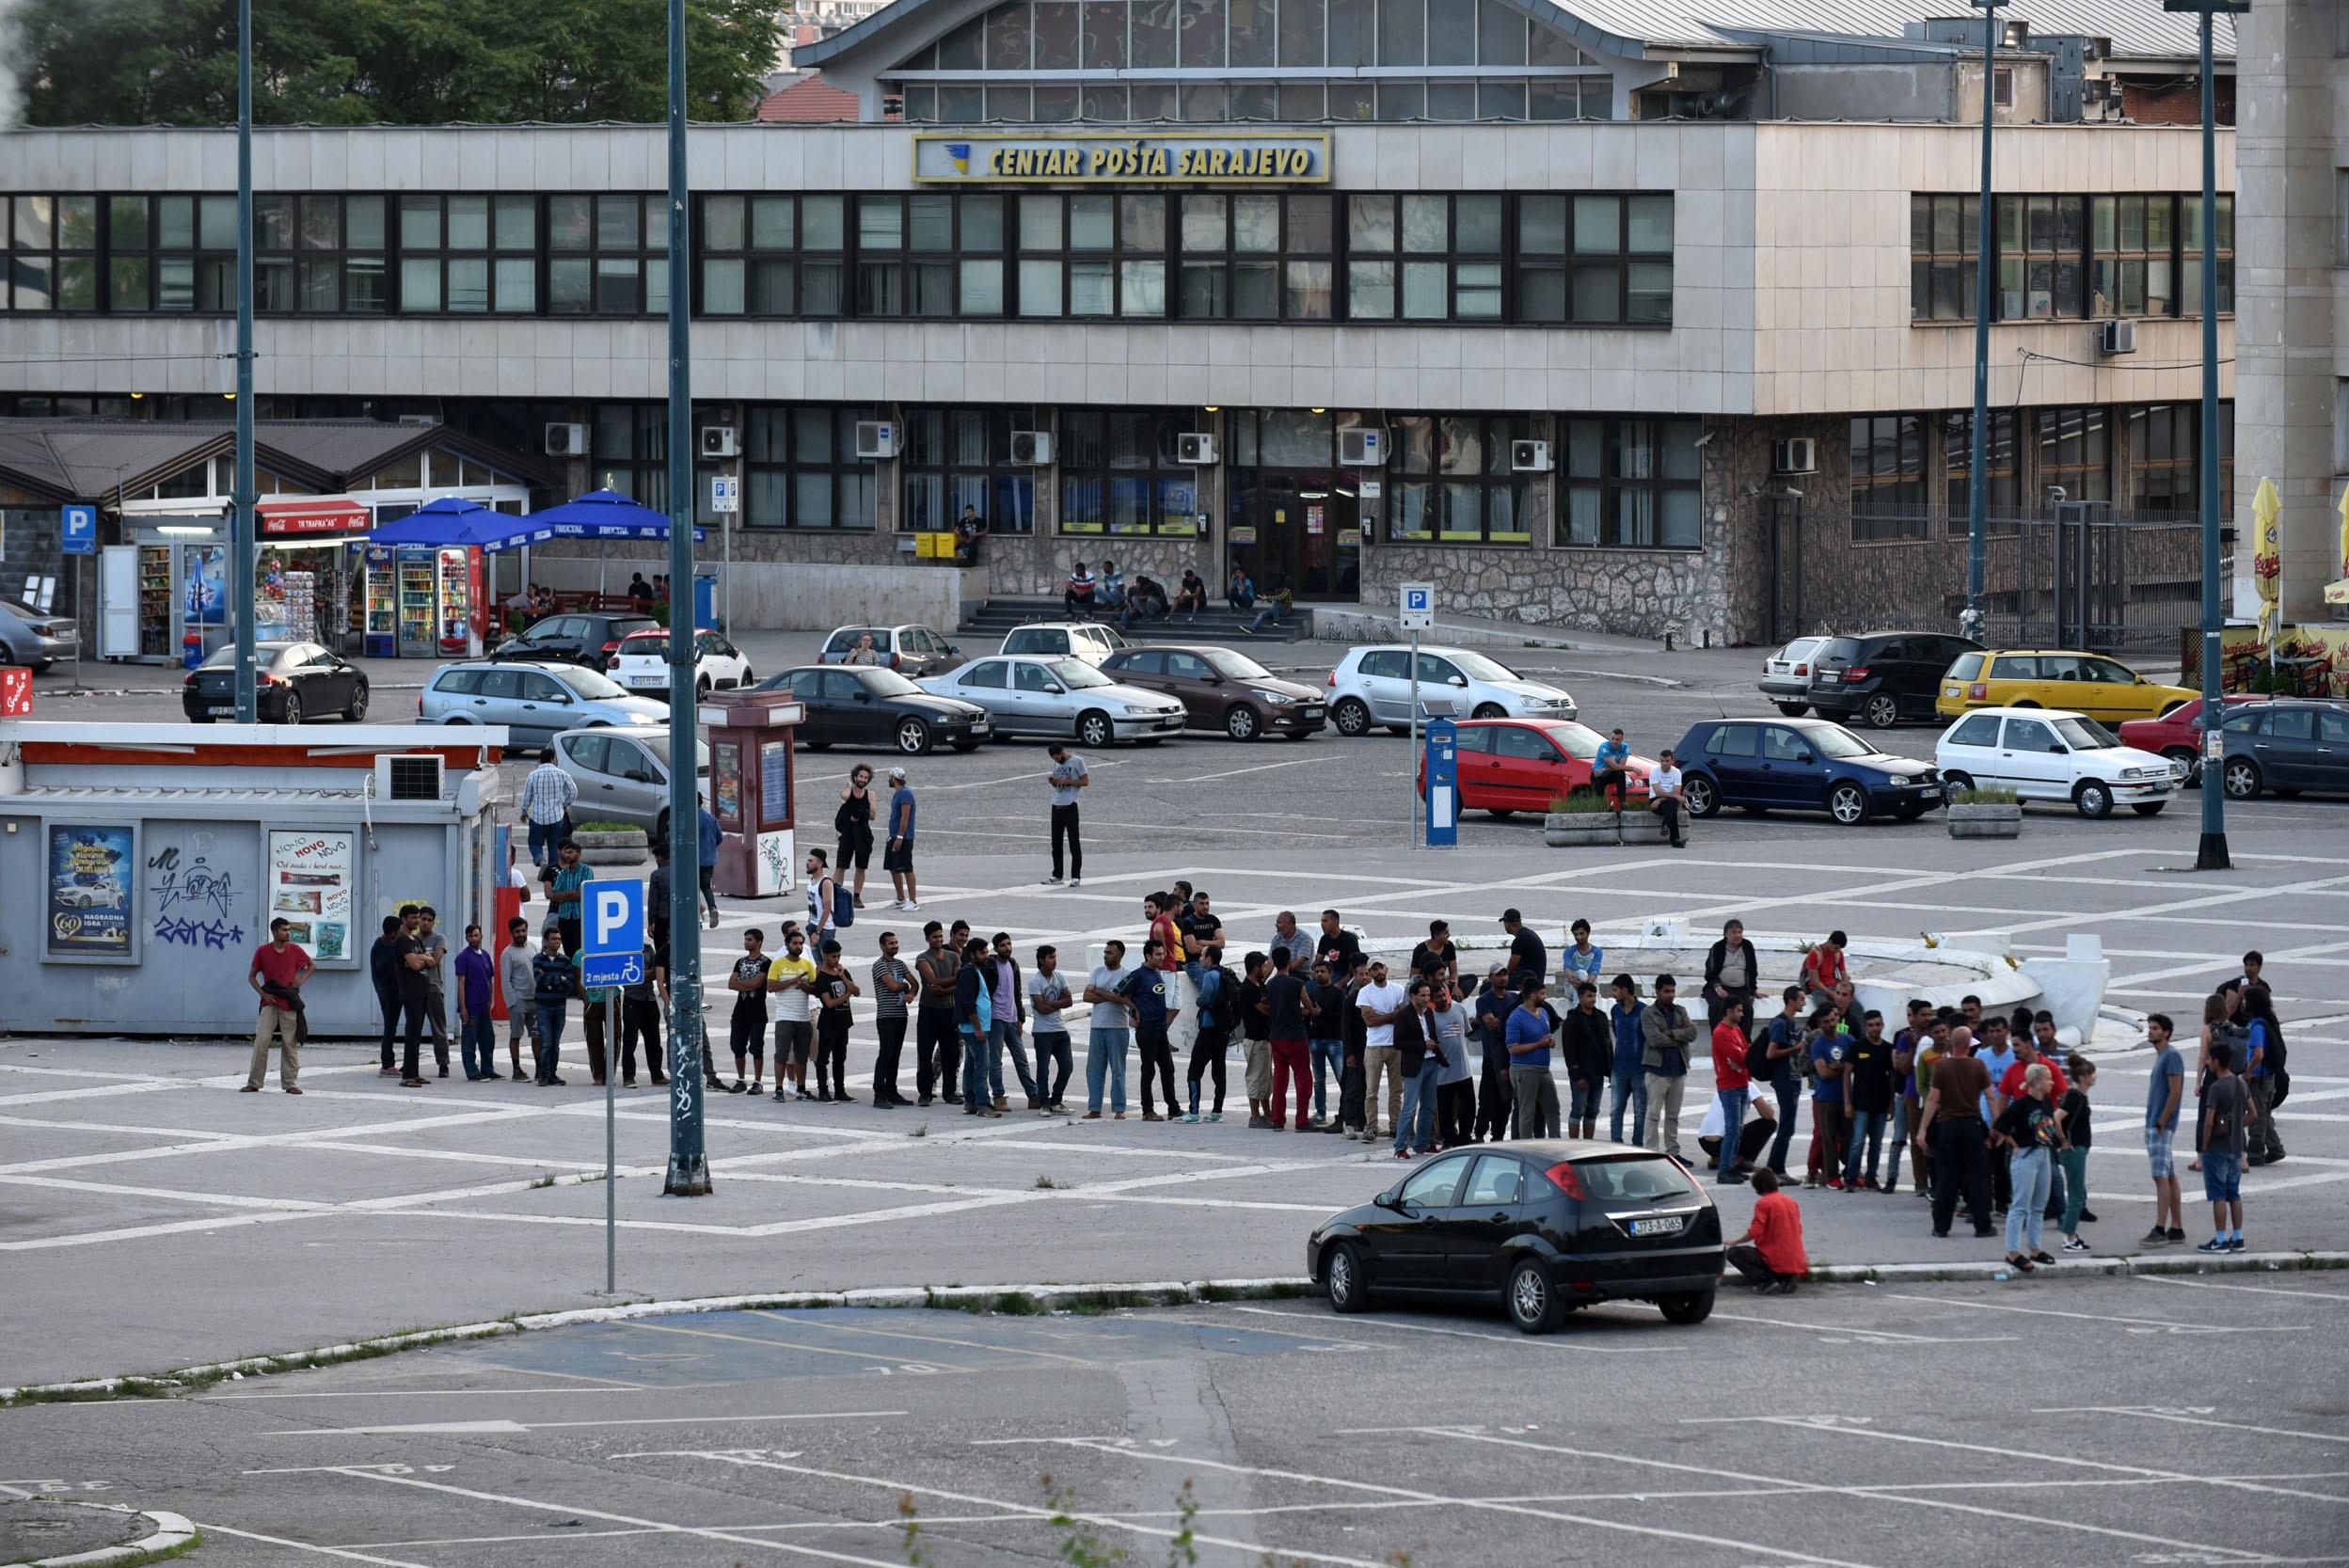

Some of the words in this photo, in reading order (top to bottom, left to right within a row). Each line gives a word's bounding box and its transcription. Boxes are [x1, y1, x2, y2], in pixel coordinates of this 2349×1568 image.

[988, 148, 1084, 175] CENTAR
[1089, 139, 1170, 175] POŠTA
[1178, 148, 1312, 176] SARAJEVO
[69, 510, 87, 535] P
[1412, 593, 1422, 607] P
[294, 840, 325, 858] NOVO
[317, 841, 347, 859] NOVO
[597, 890, 629, 944] P
[586, 973, 592, 983] 2
[593, 972, 619, 984] mjesta
